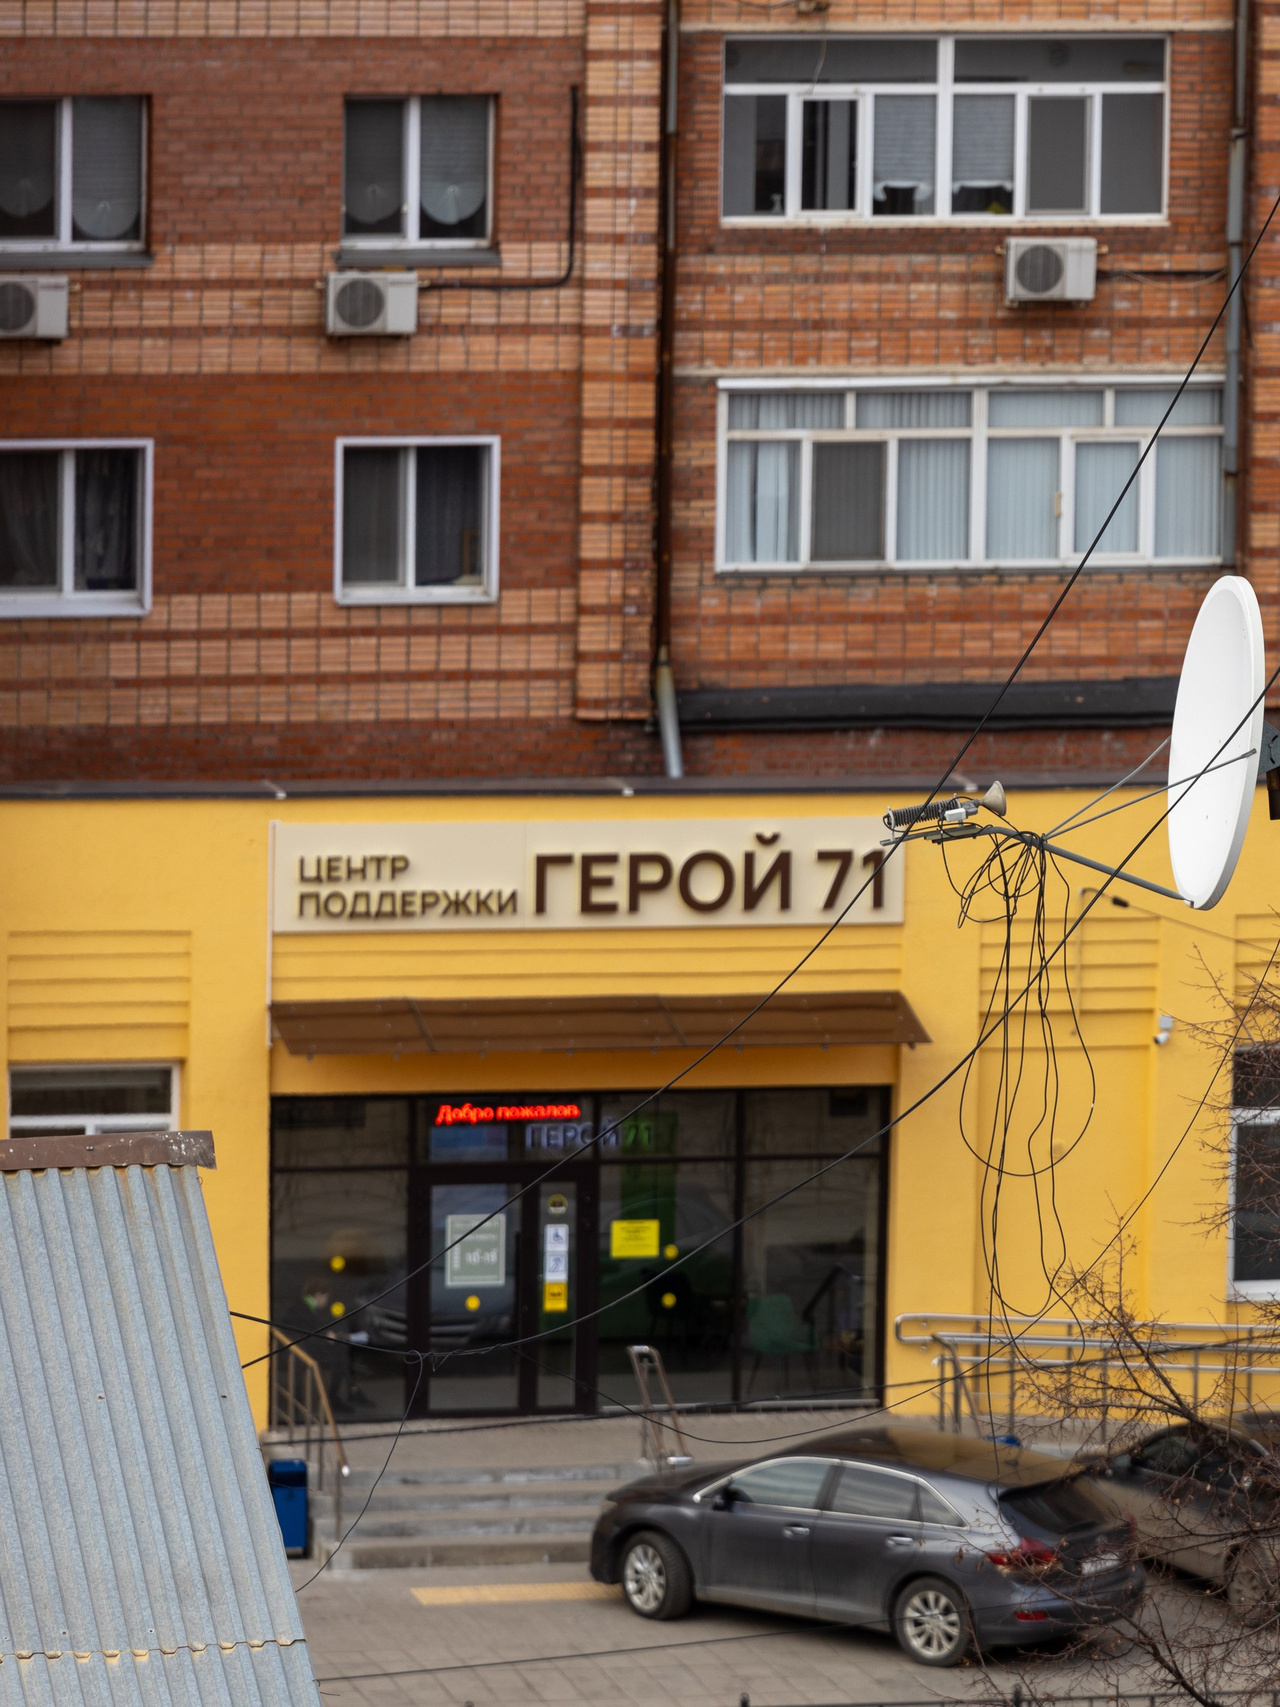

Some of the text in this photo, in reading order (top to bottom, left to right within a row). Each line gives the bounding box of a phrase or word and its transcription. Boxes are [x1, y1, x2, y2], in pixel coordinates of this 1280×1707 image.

[298, 854, 411, 884] ЦЕНТР
[534, 831, 886, 915] ГЕРОЙ 71
[298, 888, 519, 920] ПОДДЕРЖКИ
